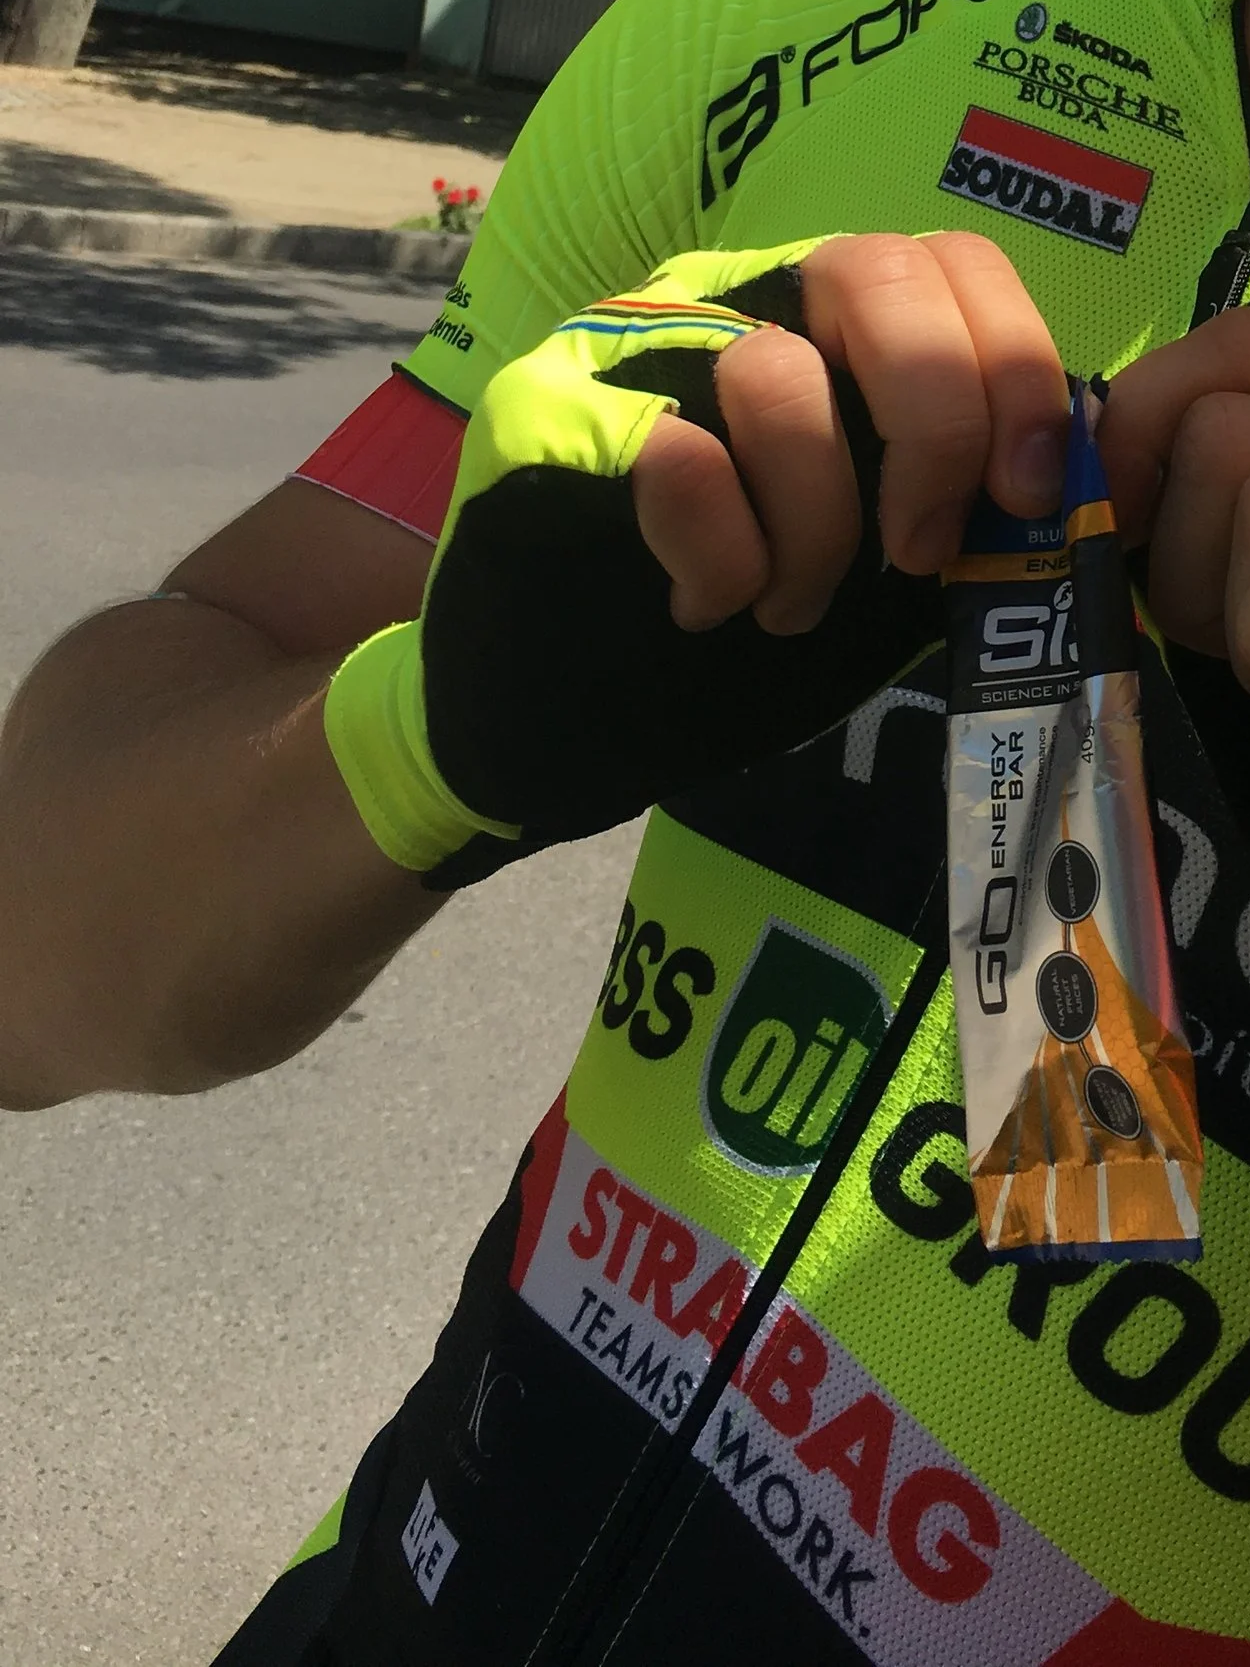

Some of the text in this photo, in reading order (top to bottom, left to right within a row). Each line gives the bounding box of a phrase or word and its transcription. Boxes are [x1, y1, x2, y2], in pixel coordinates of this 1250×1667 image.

[1053, 19, 1154, 82] ŠKODA
[976, 40, 1186, 138] PORSCHE
[1016, 81, 1110, 134] BUDA
[942, 146, 1131, 250] SOUDAL
[1028, 528, 1065, 545] BLU
[981, 685, 1053, 704] SCIENCE
[1057, 683, 1071, 696] IN
[1008, 730, 1025, 801] BAR
[975, 731, 1018, 1015] GO ENERGY
[1064, 848, 1076, 915] VEGETARIAN
[1051, 968, 1066, 1028] NATURAL
[1061, 978, 1073, 1014] FRUIT
[1070, 973, 1084, 1015] JUICES
[720, 1017, 870, 1149] oil
[567, 1164, 1001, 1605] STRABAG
[570, 1286, 880, 1640] TEAMS WORK.
